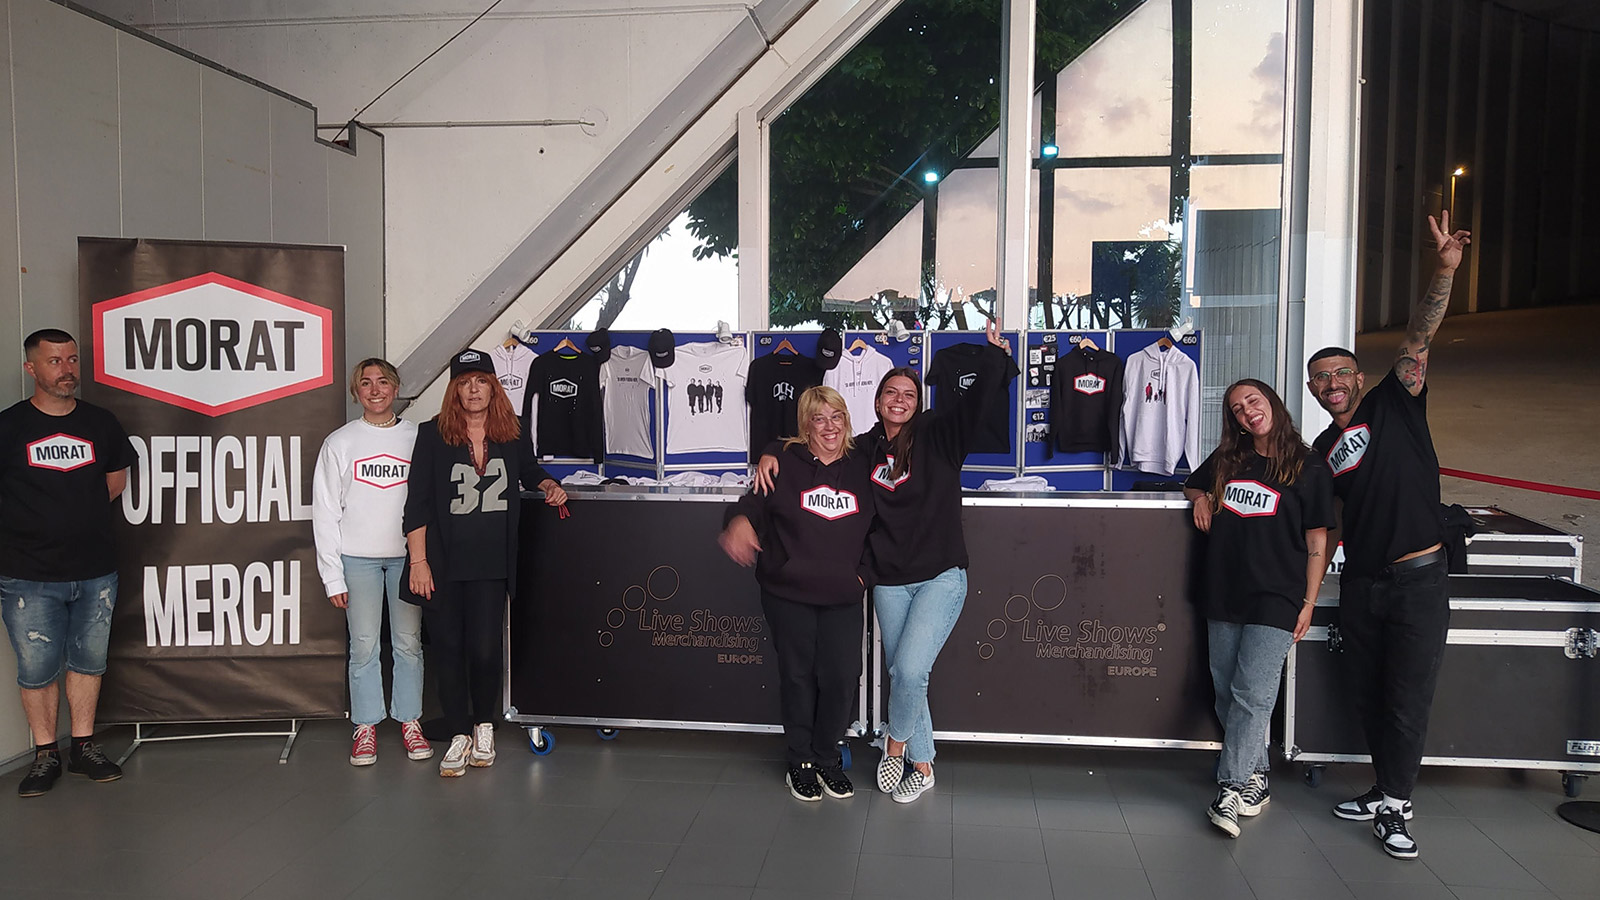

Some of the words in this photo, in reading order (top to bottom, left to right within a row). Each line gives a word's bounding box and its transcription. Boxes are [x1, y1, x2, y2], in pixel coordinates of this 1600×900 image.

[124, 318, 305, 372] MORAT
[760, 337, 772, 345] €30
[911, 336, 922, 344] €5
[1043, 335, 1057, 343] €25
[1183, 336, 1197, 344] €60
[552, 383, 575, 394] MORAT
[1077, 379, 1101, 389] MORAT
[1032, 412, 1045, 421] €12
[35, 444, 86, 461] MORAT
[1329, 431, 1367, 471] MORAT
[361, 463, 407, 479] MORAT
[121, 435, 314, 525] OFFICIAL
[449, 457, 508, 515] 32
[808, 493, 850, 510] MORAT
[1224, 486, 1272, 510] MORAT
[143, 560, 301, 647] MERCH
[638, 608, 685, 632] Live
[689, 608, 763, 633] Shows
[1021, 618, 1072, 643] Live
[651, 630, 760, 652] Merchandising
[717, 653, 764, 665] EUROPE
[1035, 642, 1154, 665] Merchandising
[1106, 665, 1158, 677] EUROPE
